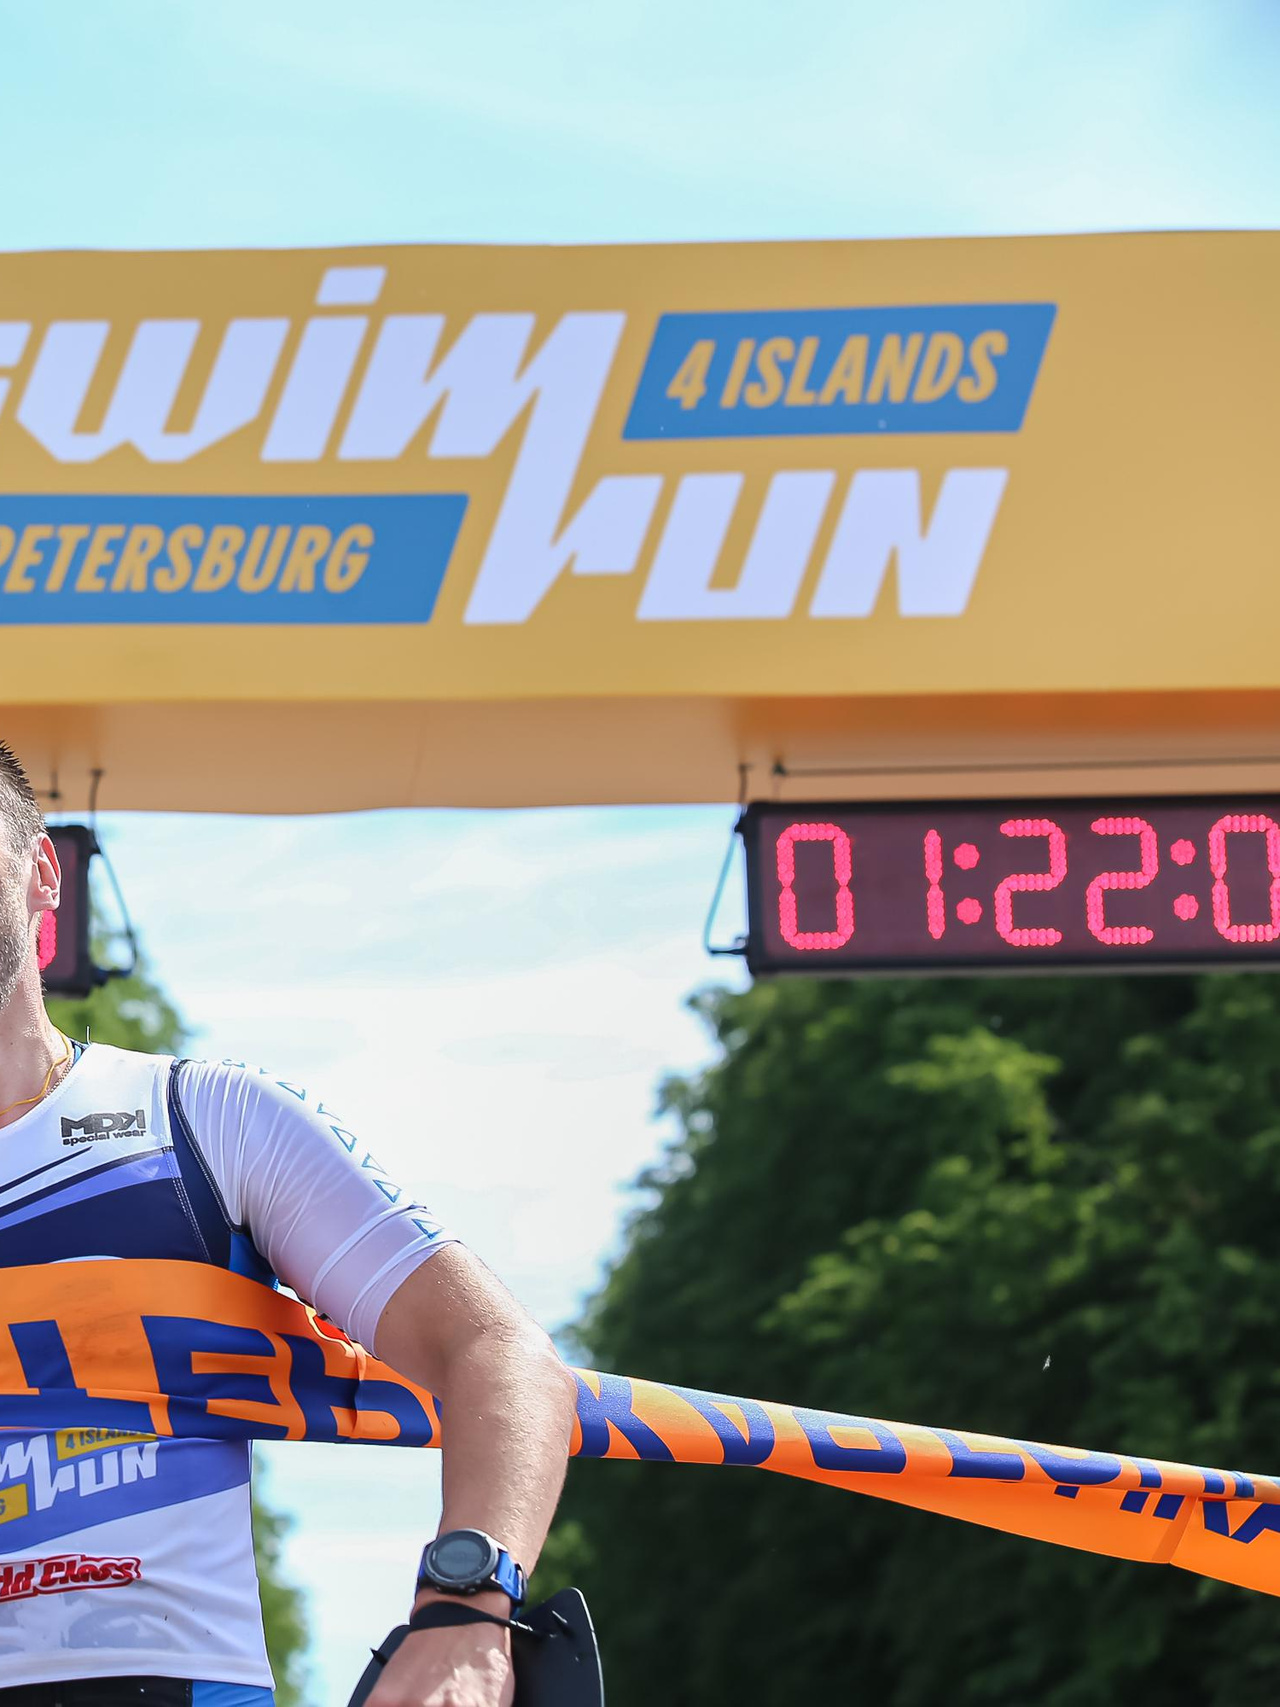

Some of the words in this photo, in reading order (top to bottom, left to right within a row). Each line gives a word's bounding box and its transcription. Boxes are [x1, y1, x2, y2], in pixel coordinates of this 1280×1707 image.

[665, 339, 716, 410] 4
[720, 330, 1009, 409] ISLANDS
[62, 1131, 111, 1147] special
[113, 1129, 147, 1139] wear
